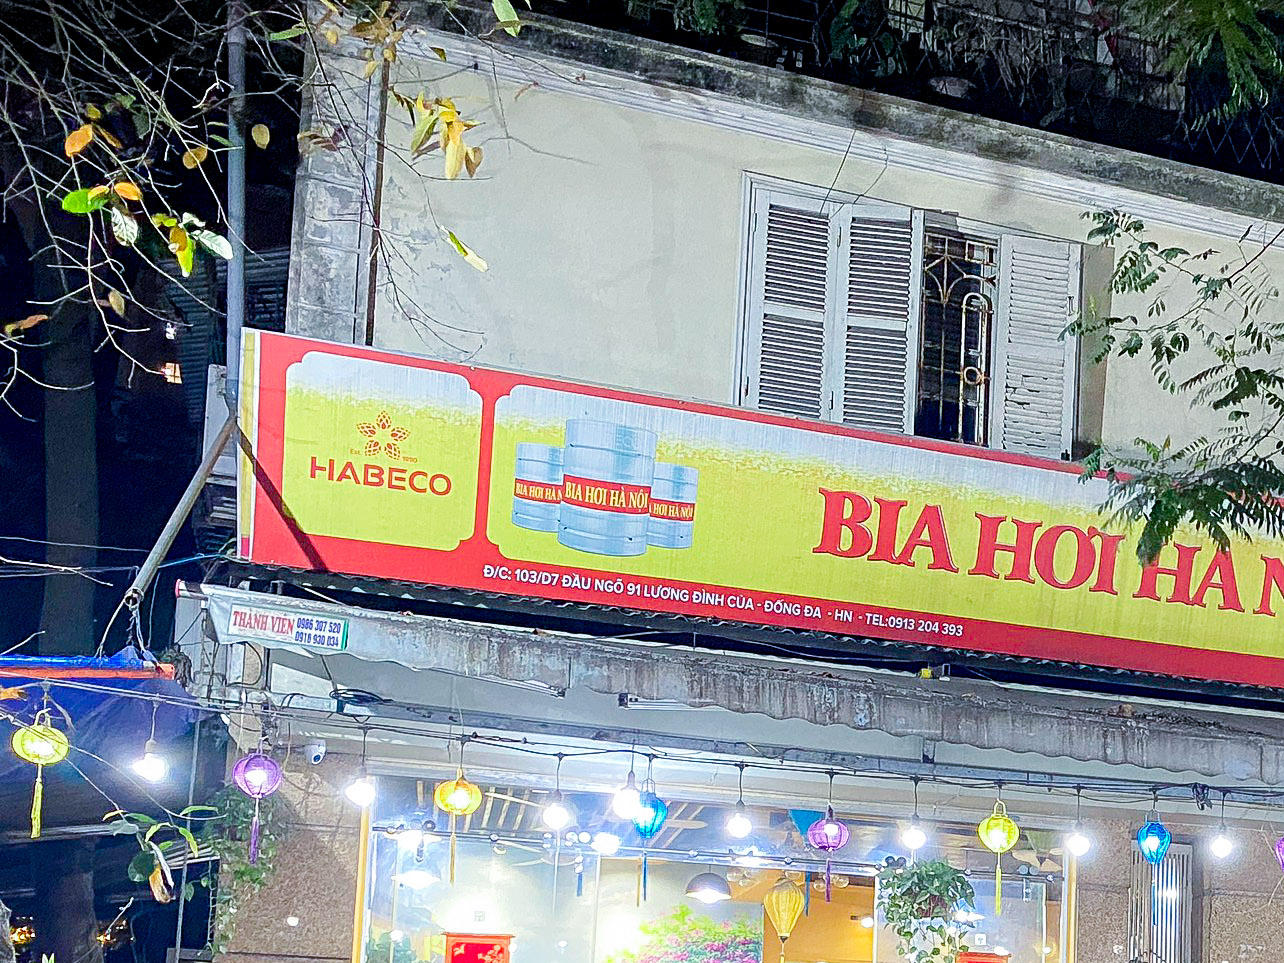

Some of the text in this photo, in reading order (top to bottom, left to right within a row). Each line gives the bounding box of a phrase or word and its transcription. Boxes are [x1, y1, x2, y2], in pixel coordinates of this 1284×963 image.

[309, 456, 453, 496] HABECO
[564, 481, 583, 501] BIA
[609, 486, 627, 509] HÀ
[629, 492, 649, 513] NỘI
[812, 486, 960, 575] BIA
[967, 511, 1126, 596] HƠI
[482, 564, 513, 581] Đ/C:
[514, 568, 559, 587] 103/D7
[593, 578, 624, 595] NGÕ
[626, 583, 641, 597] 91
[643, 584, 690, 602] LƯƠNG
[691, 588, 725, 607] ĐÌNH
[763, 598, 802, 616] ĐỐNG
[803, 605, 822, 619] ĐA
[834, 609, 853, 623] HN
[865, 613, 916, 631] TEL:0913
[917, 619, 940, 634] 204
[941, 623, 964, 637] 393
[296, 617, 313, 630] 0986
[329, 621, 341, 634] 520
[313, 633, 325, 645] 930
